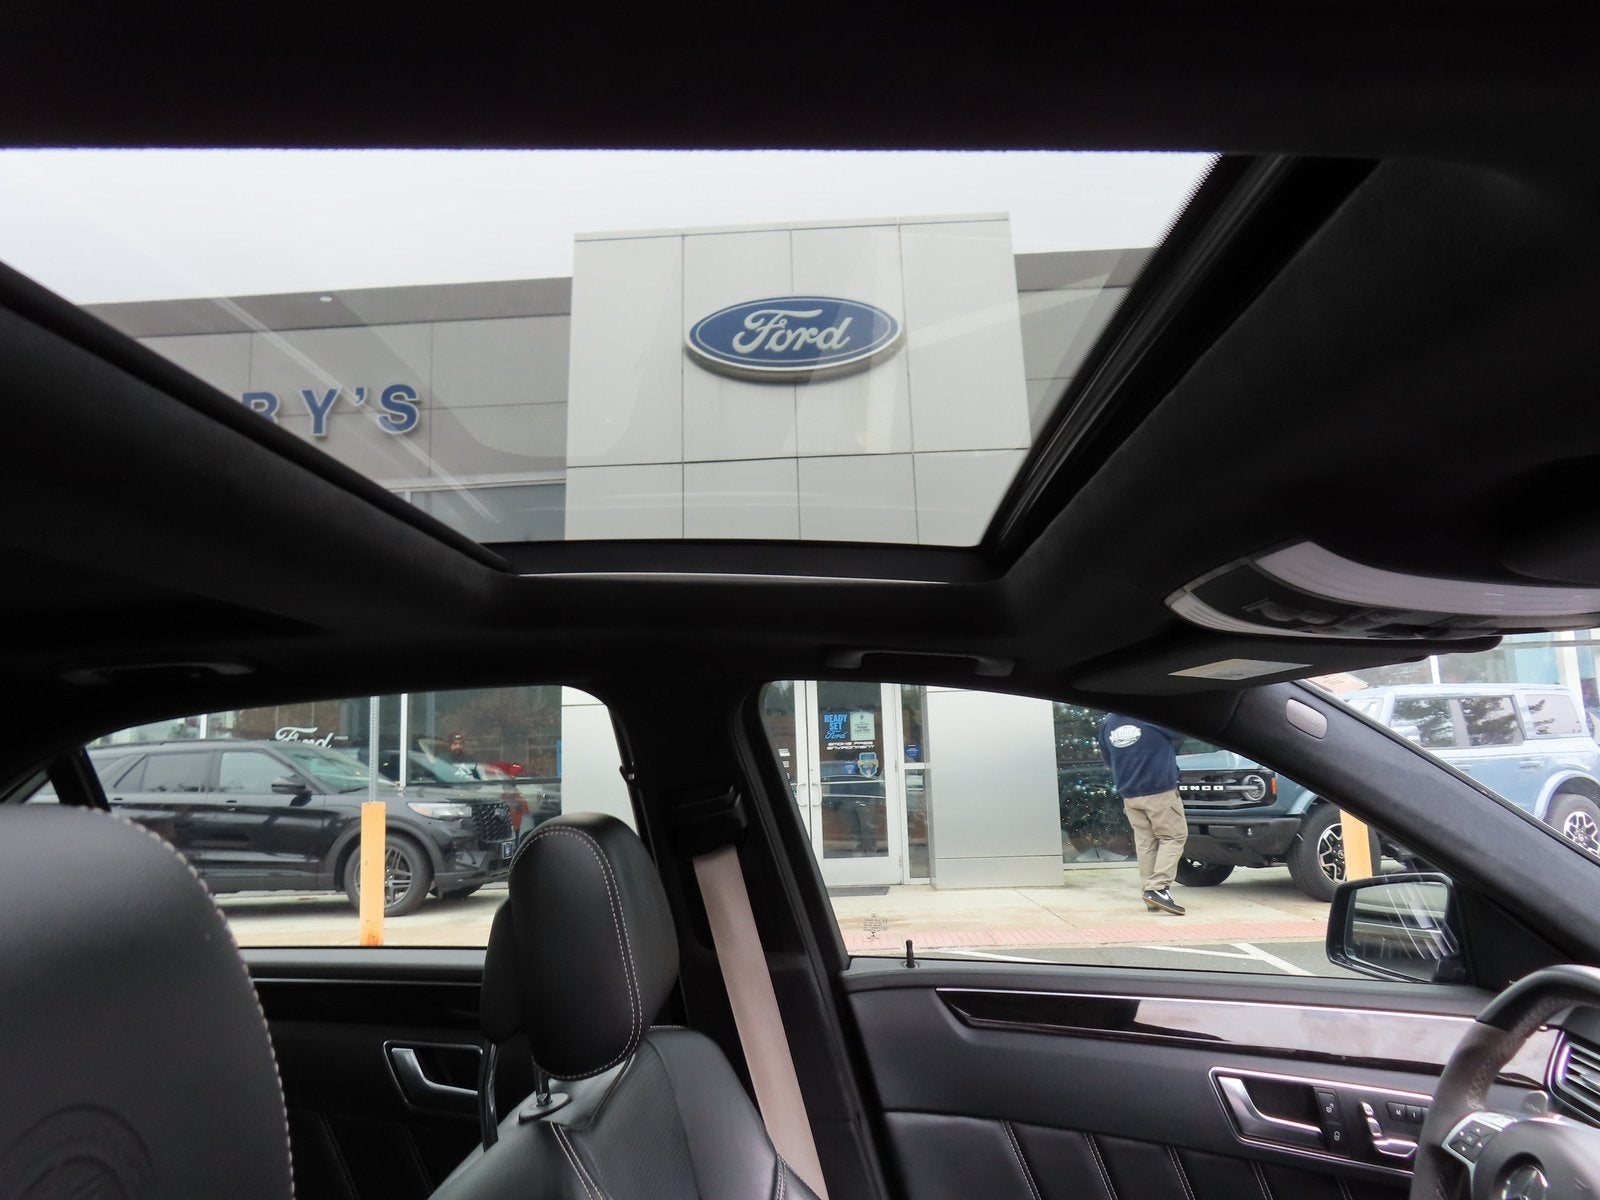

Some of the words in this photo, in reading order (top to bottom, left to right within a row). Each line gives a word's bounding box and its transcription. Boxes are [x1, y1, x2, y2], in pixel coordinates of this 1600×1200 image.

[732, 309, 853, 354] Ford
[824, 714, 848, 723] READY
[830, 722, 842, 731] SET
[825, 730, 848, 739] Ford
